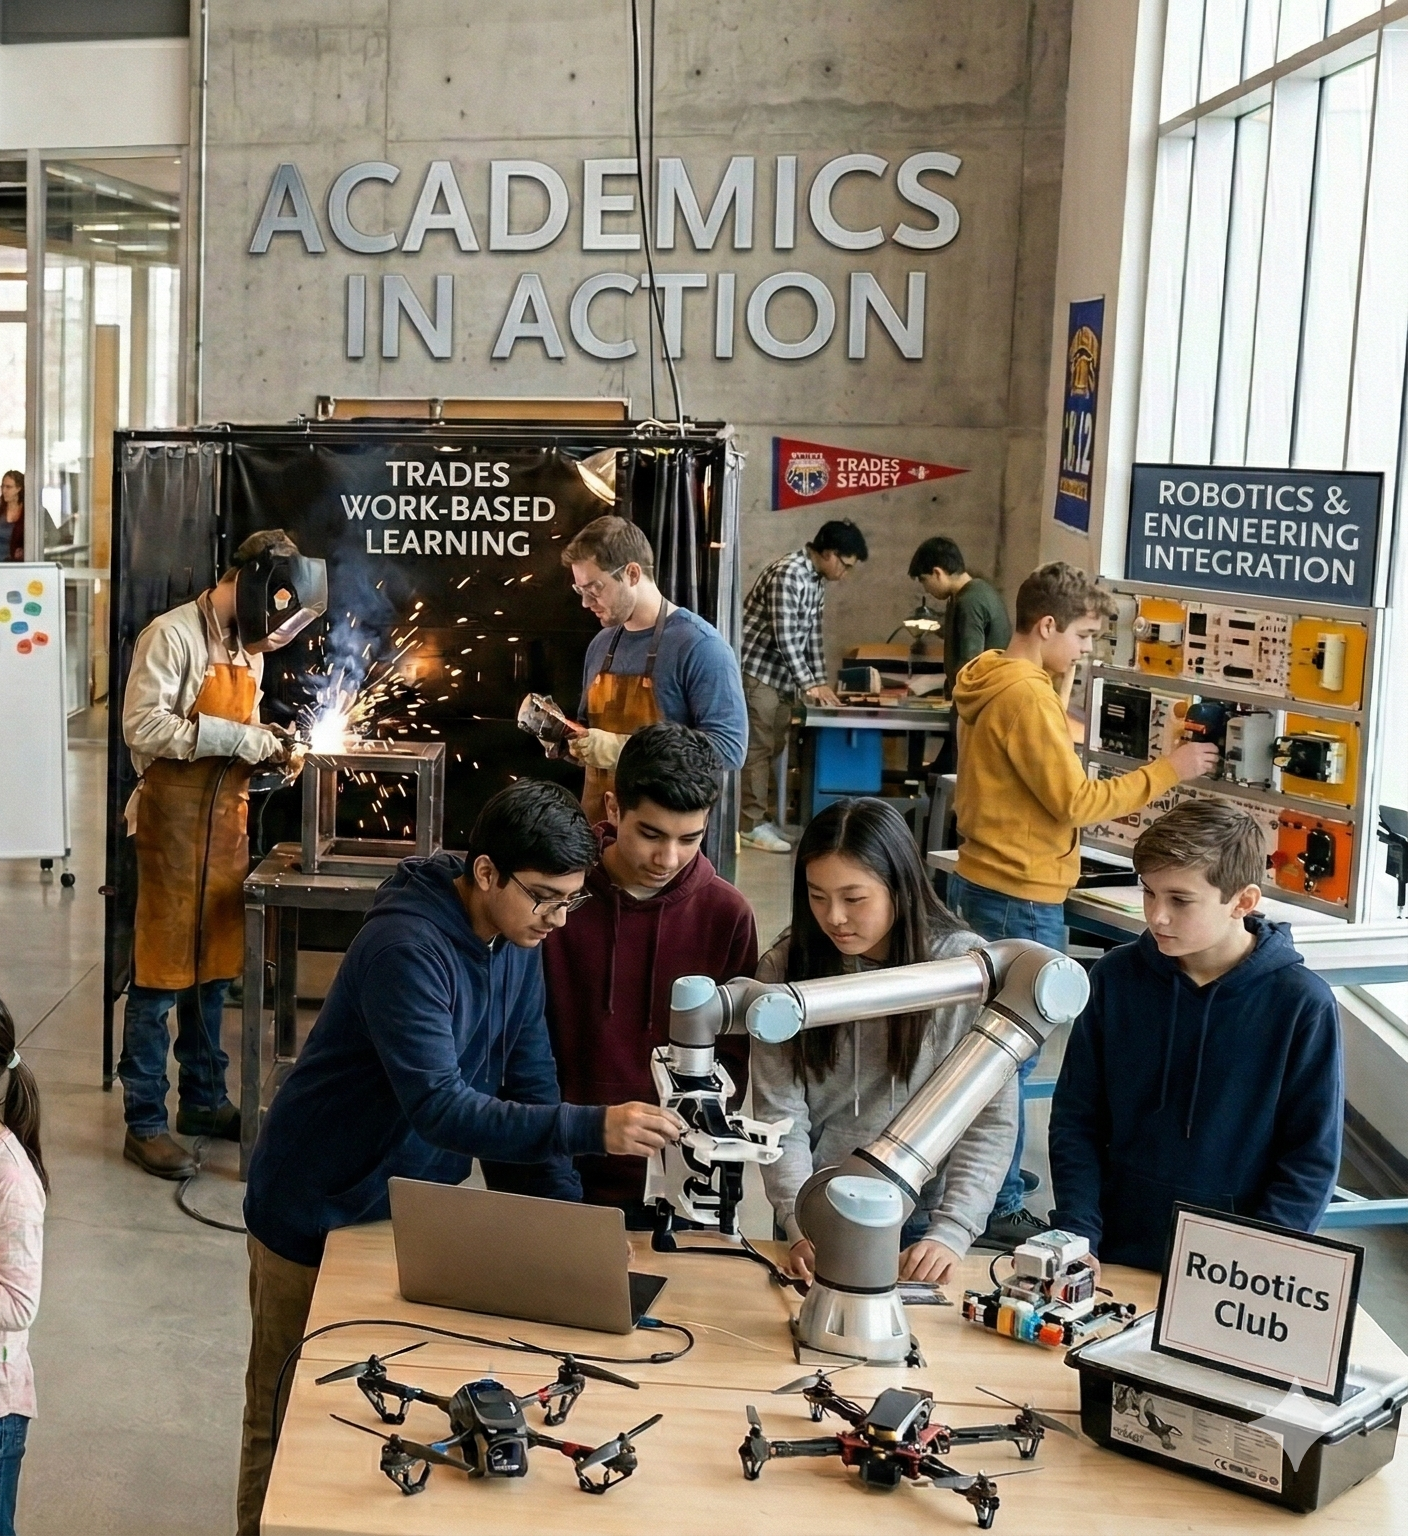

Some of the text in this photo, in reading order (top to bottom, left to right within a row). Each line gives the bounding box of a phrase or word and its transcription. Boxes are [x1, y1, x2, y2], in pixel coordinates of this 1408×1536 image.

[248, 151, 963, 254] ACADEMICS
[345, 271, 928, 360] IN ACTION
[385, 461, 511, 488] TRADES
[836, 457, 901, 472] TRADES
[836, 472, 902, 488] SEADEY
[340, 494, 557, 522] WORK-BASED
[1158, 480, 1352, 515] ROBOTICS &
[365, 529, 531, 557] LEARNING
[1144, 512, 1361, 551] ENGINEERING
[1145, 544, 1356, 586] INTEGRATION
[1185, 1250, 1331, 1312] Robotics
[1214, 1299, 1289, 1343] Club
